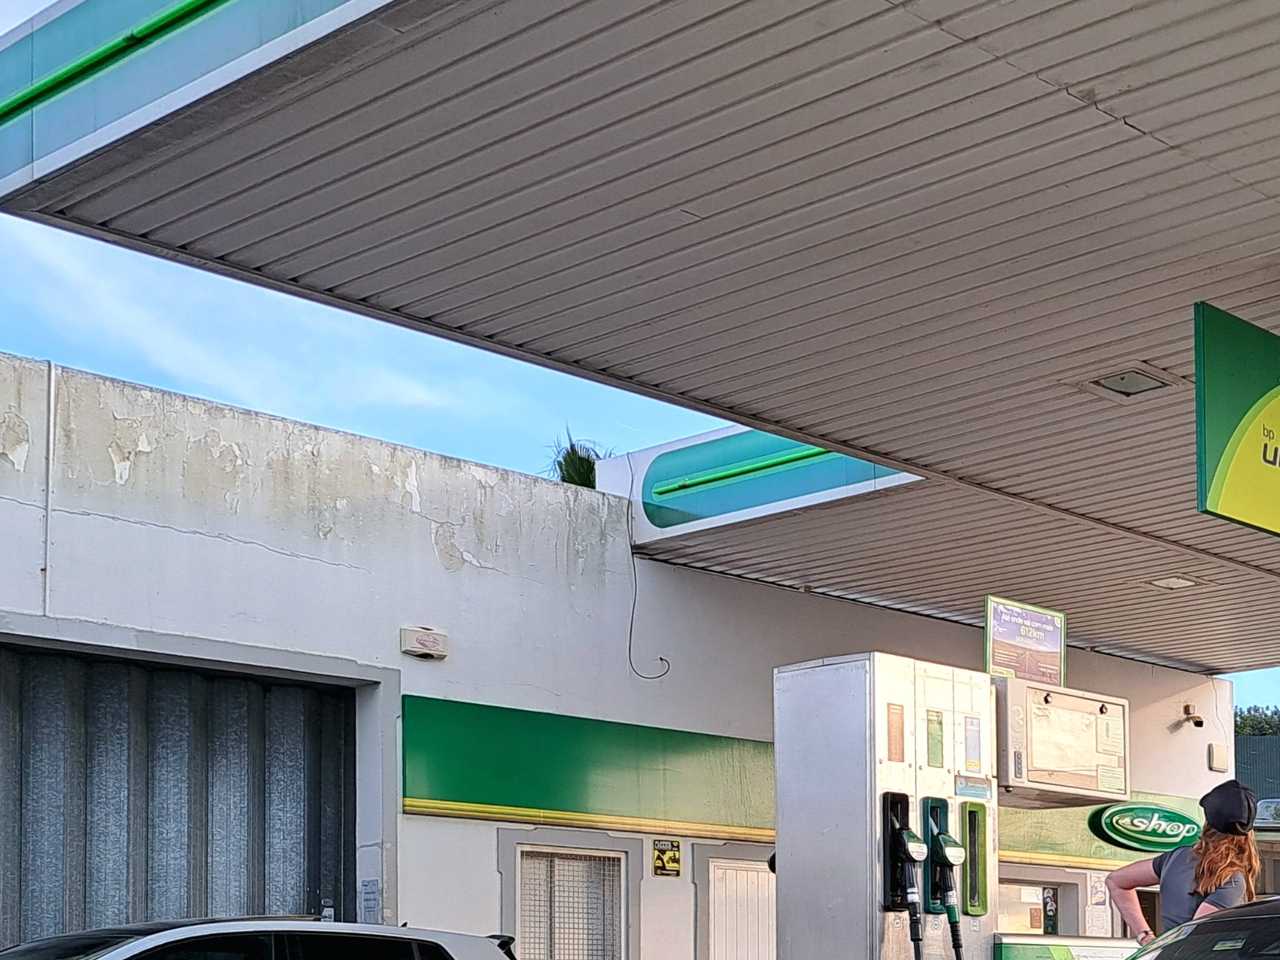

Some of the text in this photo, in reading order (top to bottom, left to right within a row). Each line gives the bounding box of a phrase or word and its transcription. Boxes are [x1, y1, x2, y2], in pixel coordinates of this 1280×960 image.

[1262, 423, 1275, 442] bp
[1011, 616, 1023, 625] onde
[1020, 626, 1045, 640] 612km
[1131, 812, 1198, 843] shop
